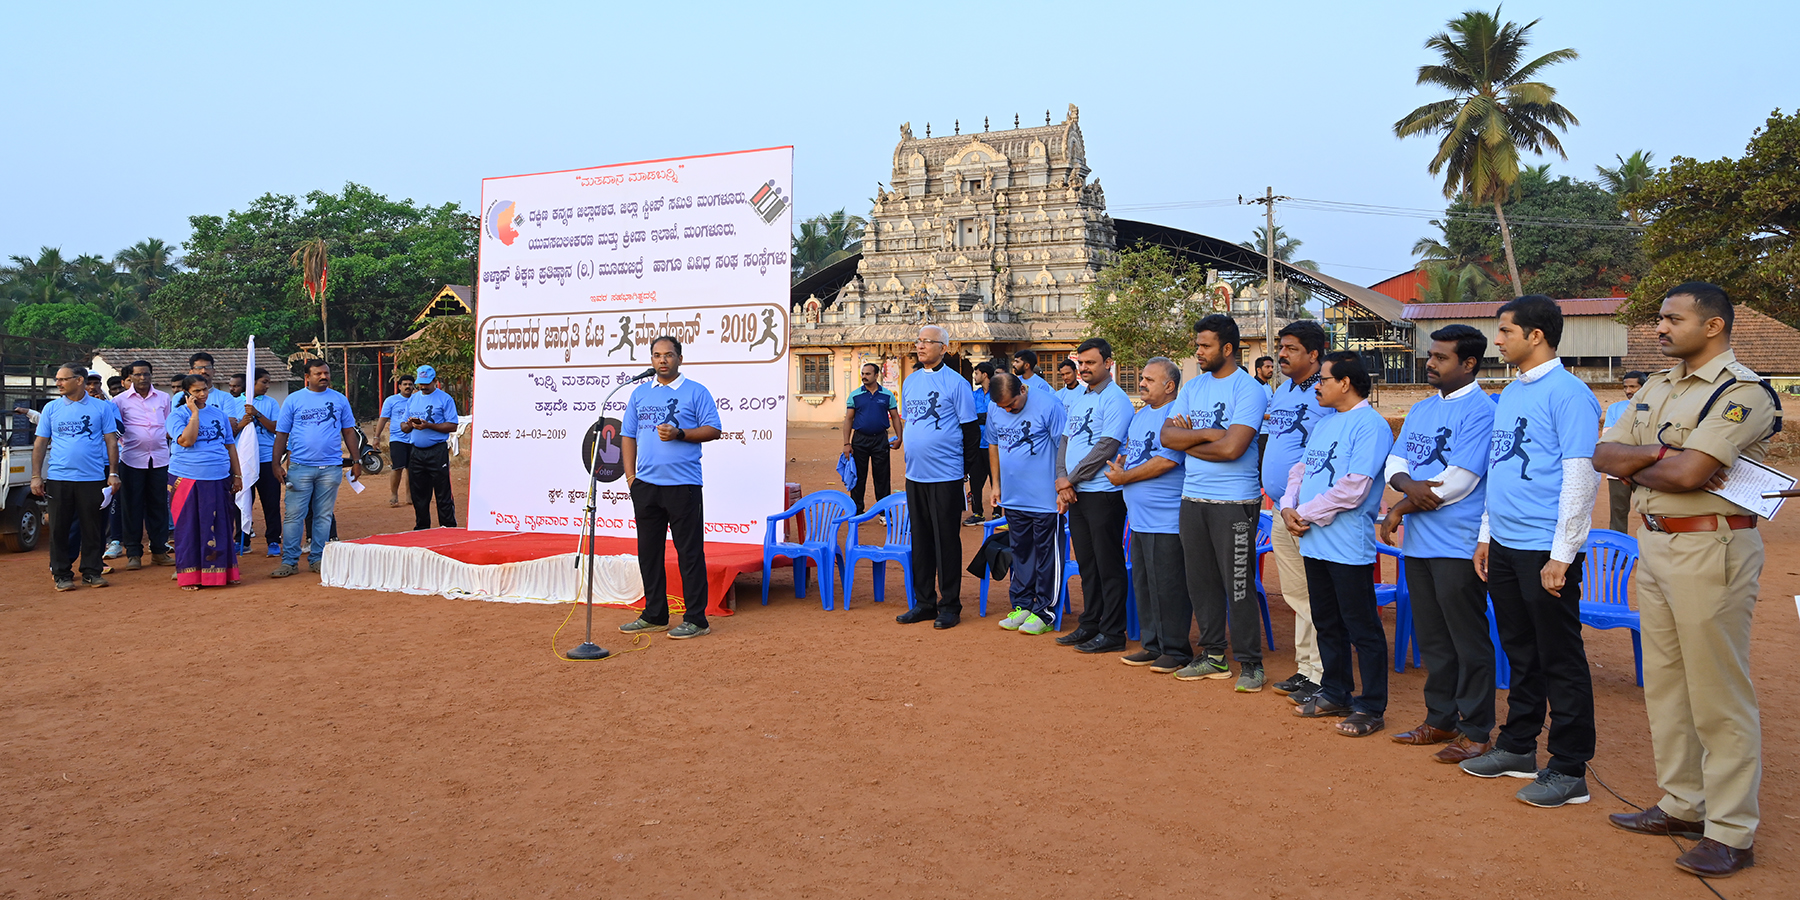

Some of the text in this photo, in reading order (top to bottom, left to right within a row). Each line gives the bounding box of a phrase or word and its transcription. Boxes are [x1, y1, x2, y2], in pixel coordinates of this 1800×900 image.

[529, 210, 548, 228] ದಕ್ಷಿಣ
[552, 207, 573, 226] ಕನ್ನಡ
[620, 202, 638, 219] ಜಿಲ್ಲಾ
[668, 196, 692, 210] ಸಮಿತಿ
[598, 232, 618, 251] ಮತ್ತು
[622, 230, 646, 248] ಕ್ರೀಡಾ
[515, 265, 535, 288] ಶಿಕ್ಷಣ
[577, 259, 595, 280] (ರಿ.)
[653, 257, 682, 273] ಹಾಗೂ
[687, 255, 711, 272] ವಿವಿಧ
[715, 253, 739, 270] ಸಂಘ
[743, 248, 787, 276] ಸಂಸ್ಥೆಗಳು
[590, 293, 607, 303] ಇವರ
[486, 318, 541, 350] ಮತದಾರರ
[545, 317, 580, 363] ಜಾಗೃತಿ
[585, 317, 604, 348] ಓಟ
[721, 313, 757, 343] 2019
[528, 373, 558, 392] “ಬನ್ನಿ
[561, 375, 610, 388] ಮತದಾನ
[534, 399, 568, 416] ತಪ್ಪದೇ
[573, 401, 597, 412] ಮತ
[739, 395, 785, 411] 2019”
[482, 428, 511, 439] ದಿನಾಂಕ:
[751, 429, 773, 441] 7.00
[490, 511, 521, 530] “ನಿಮ್ಮ
[524, 514, 569, 530] ದೃಢವಾದ
[1233, 531, 1249, 602] WINNER
